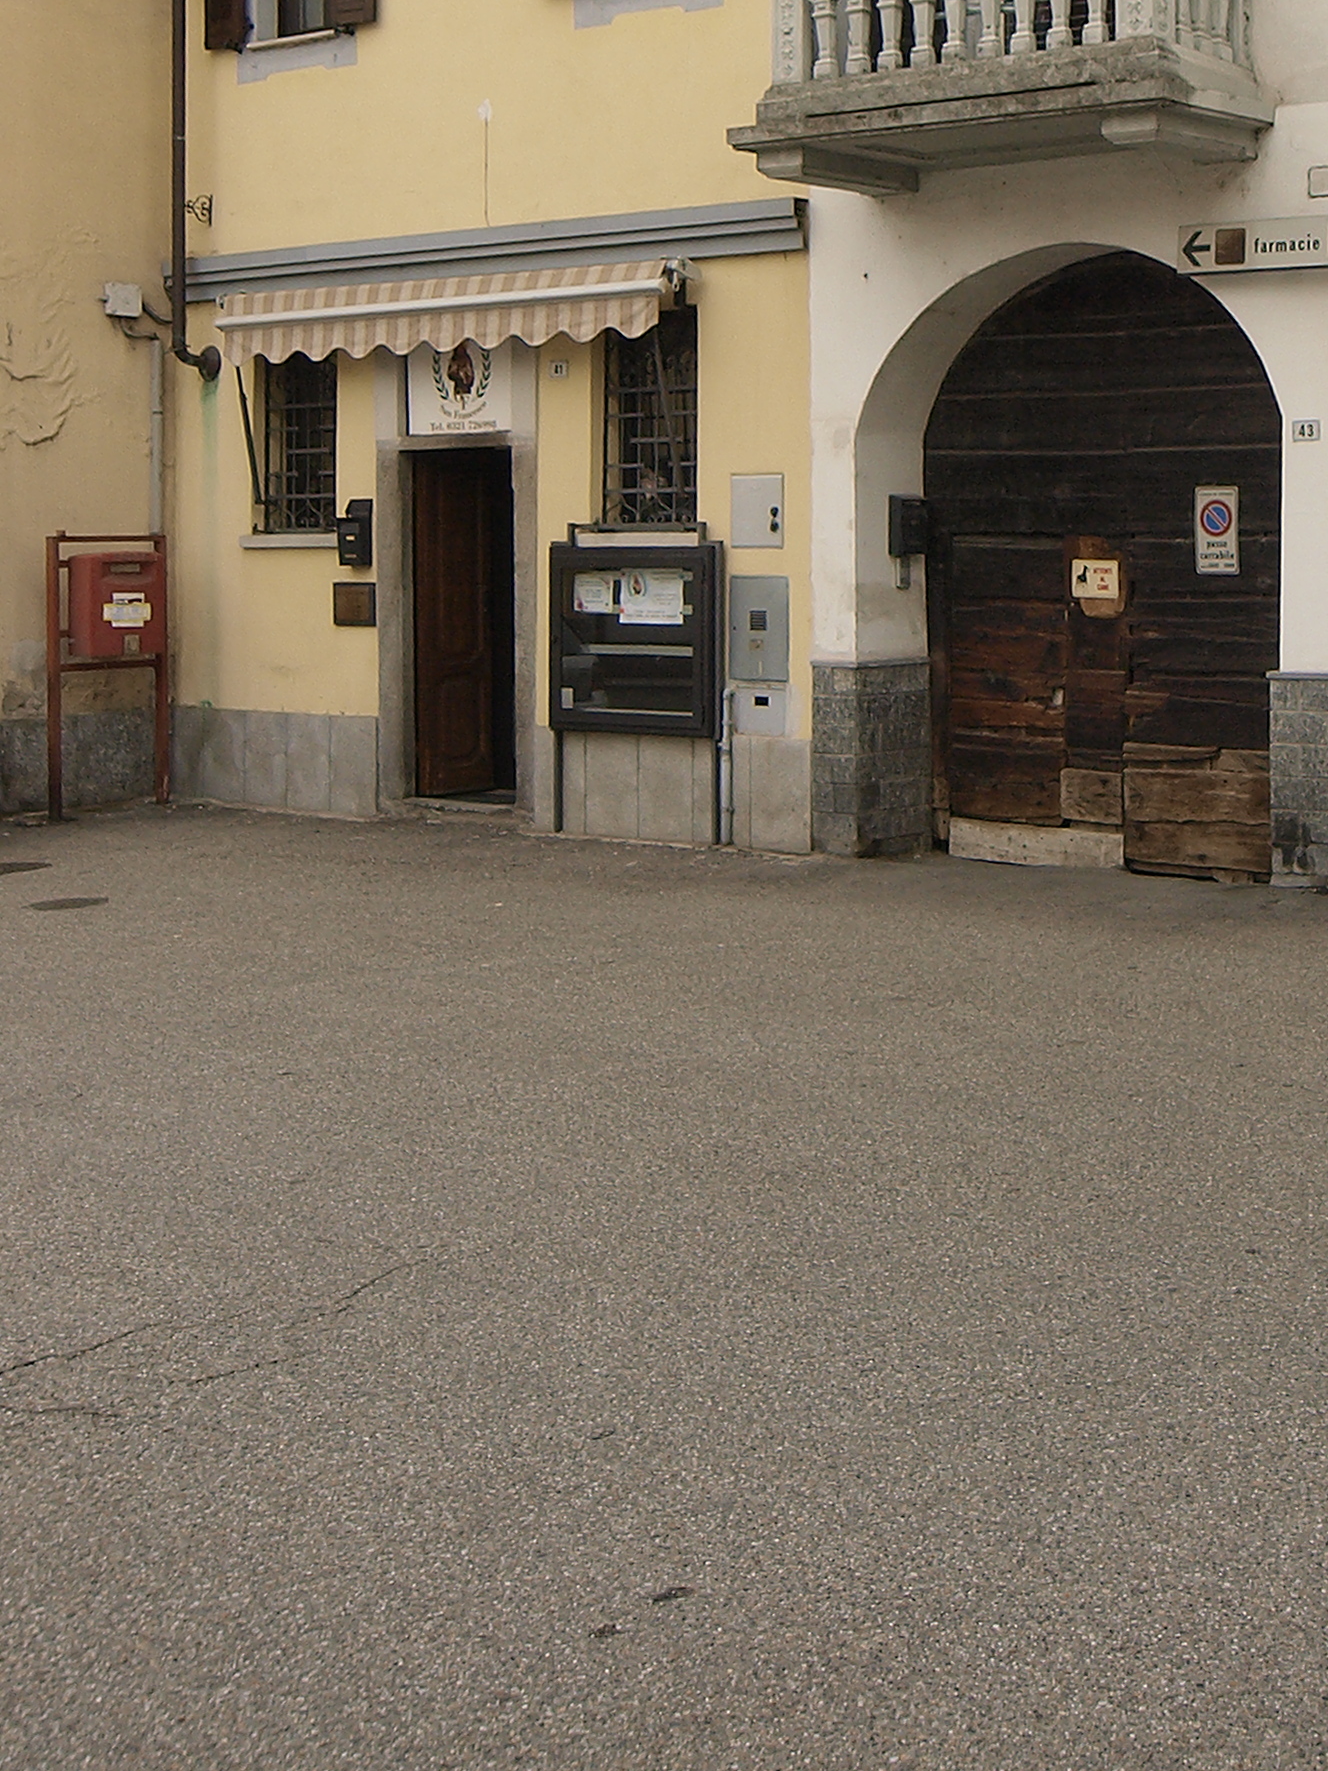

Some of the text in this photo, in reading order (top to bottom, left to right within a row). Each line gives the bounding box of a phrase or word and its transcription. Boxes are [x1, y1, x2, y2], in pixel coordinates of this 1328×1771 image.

[1253, 233, 1321, 254] farmacie
[1299, 423, 1314, 437] 43
[1200, 550, 1234, 560] carrabile
